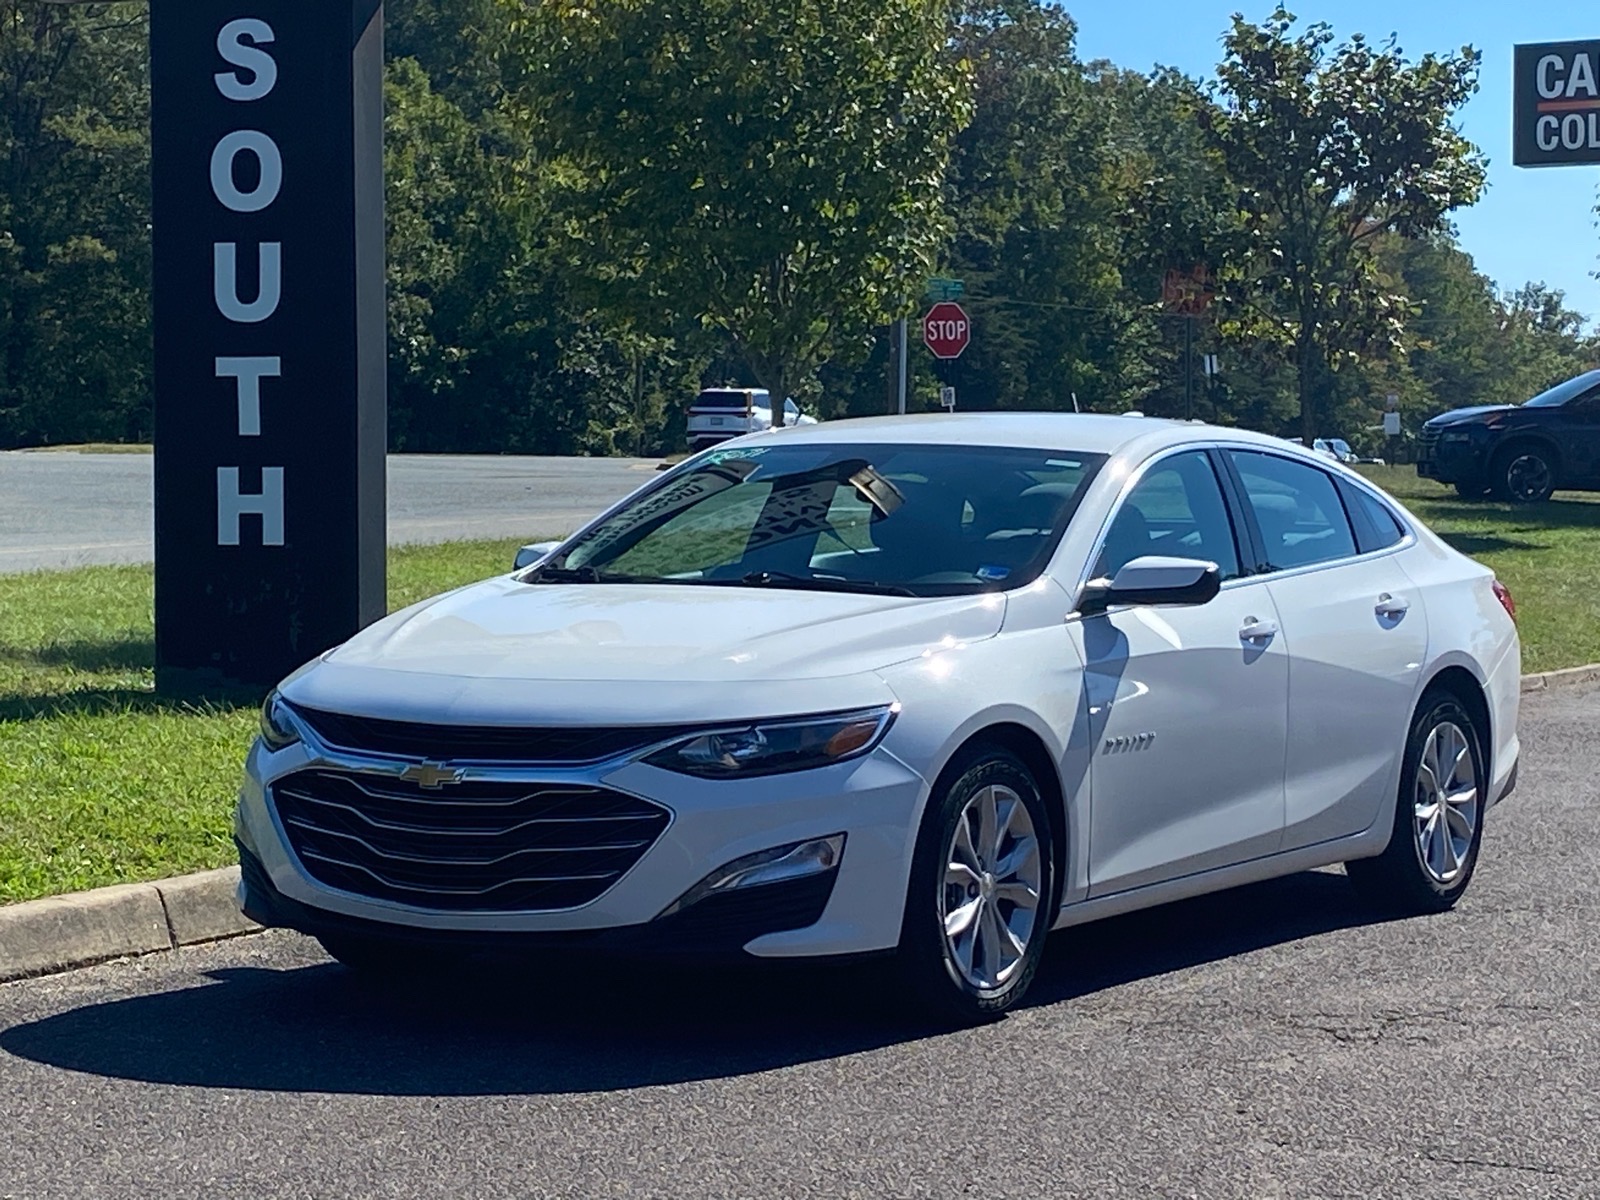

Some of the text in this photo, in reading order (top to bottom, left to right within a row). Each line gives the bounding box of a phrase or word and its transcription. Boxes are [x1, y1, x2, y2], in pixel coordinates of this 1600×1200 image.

[1537, 53, 1598, 99] CA
[1536, 113, 1600, 151] COL
[211, 19, 284, 545] SOUTH
[928, 320, 966, 342] STOP
